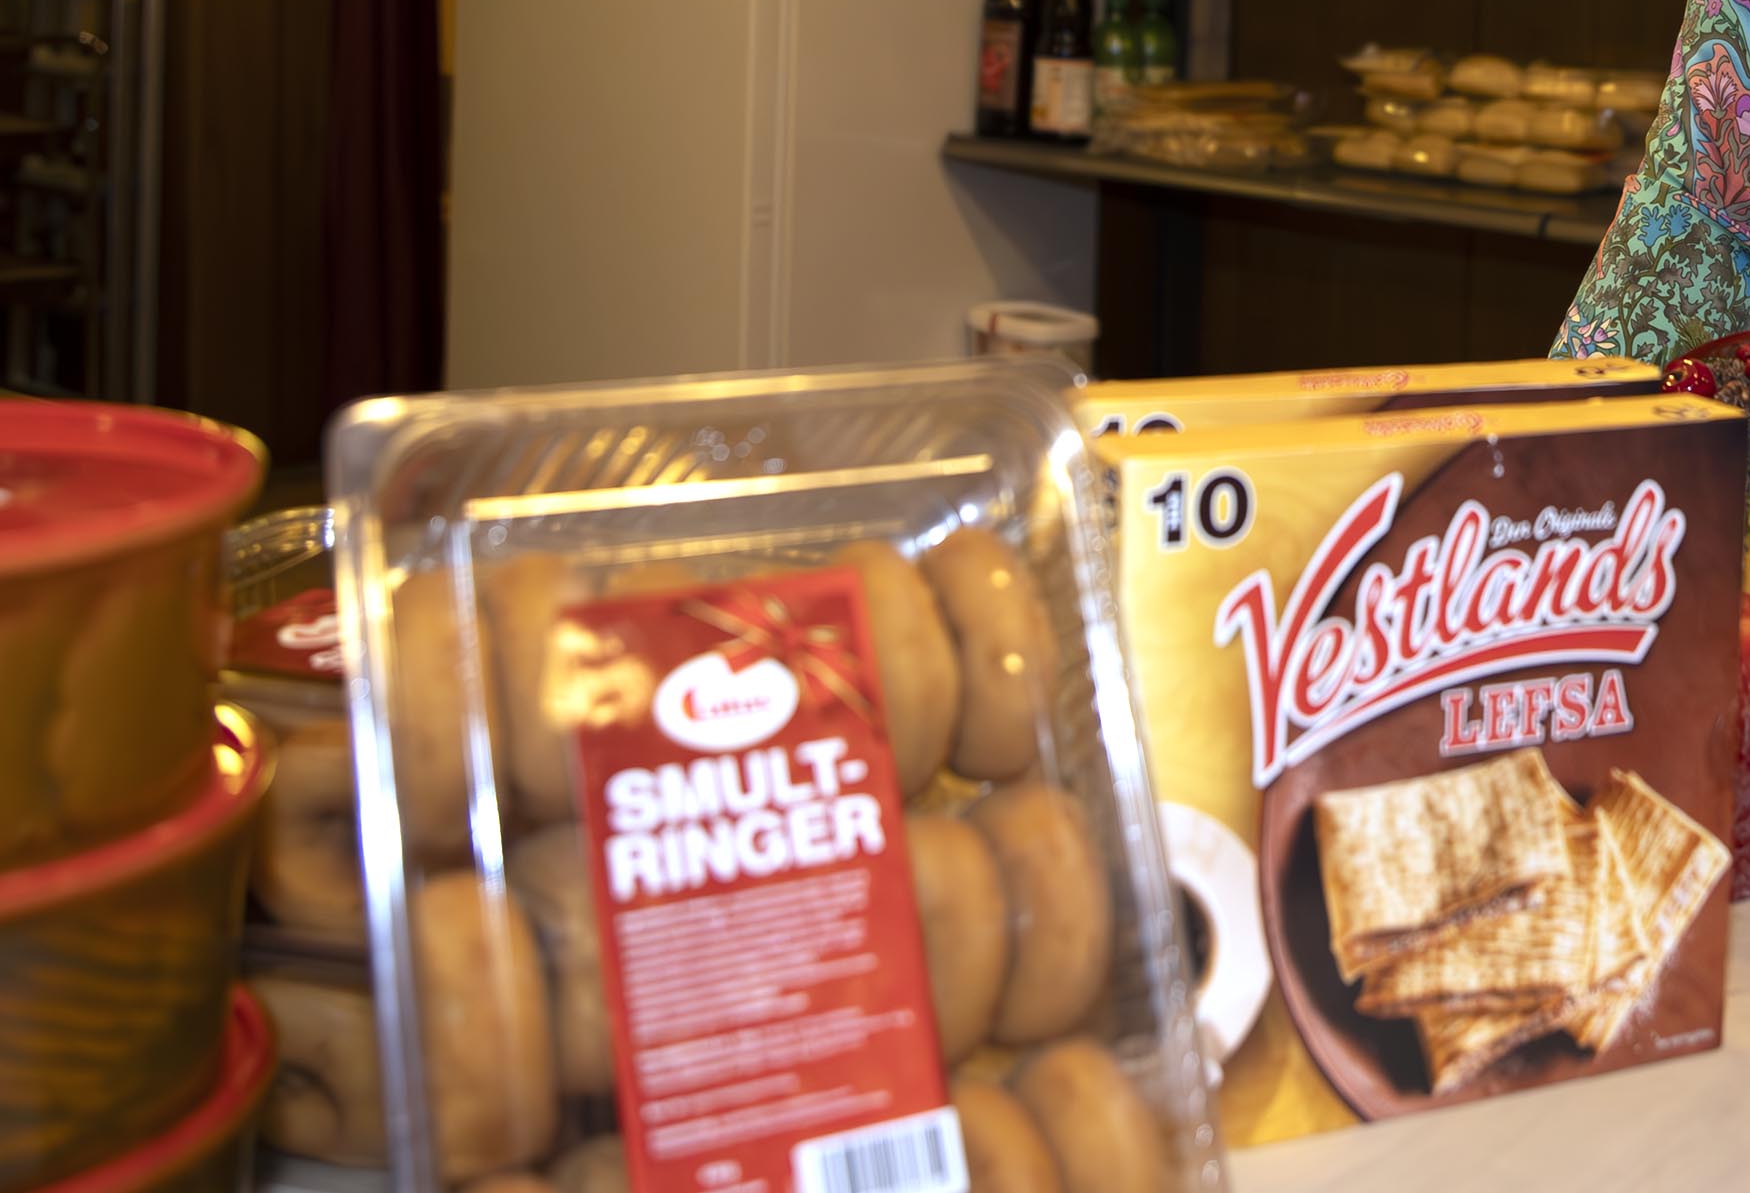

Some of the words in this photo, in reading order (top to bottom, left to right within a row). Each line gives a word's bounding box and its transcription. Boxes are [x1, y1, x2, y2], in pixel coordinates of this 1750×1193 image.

[1147, 466, 1256, 551] 10
[1214, 471, 1686, 788] Vestlands
[1440, 669, 1634, 756] LEFSA
[606, 736, 868, 834] SMULT-
[606, 792, 886, 902] RINGER
